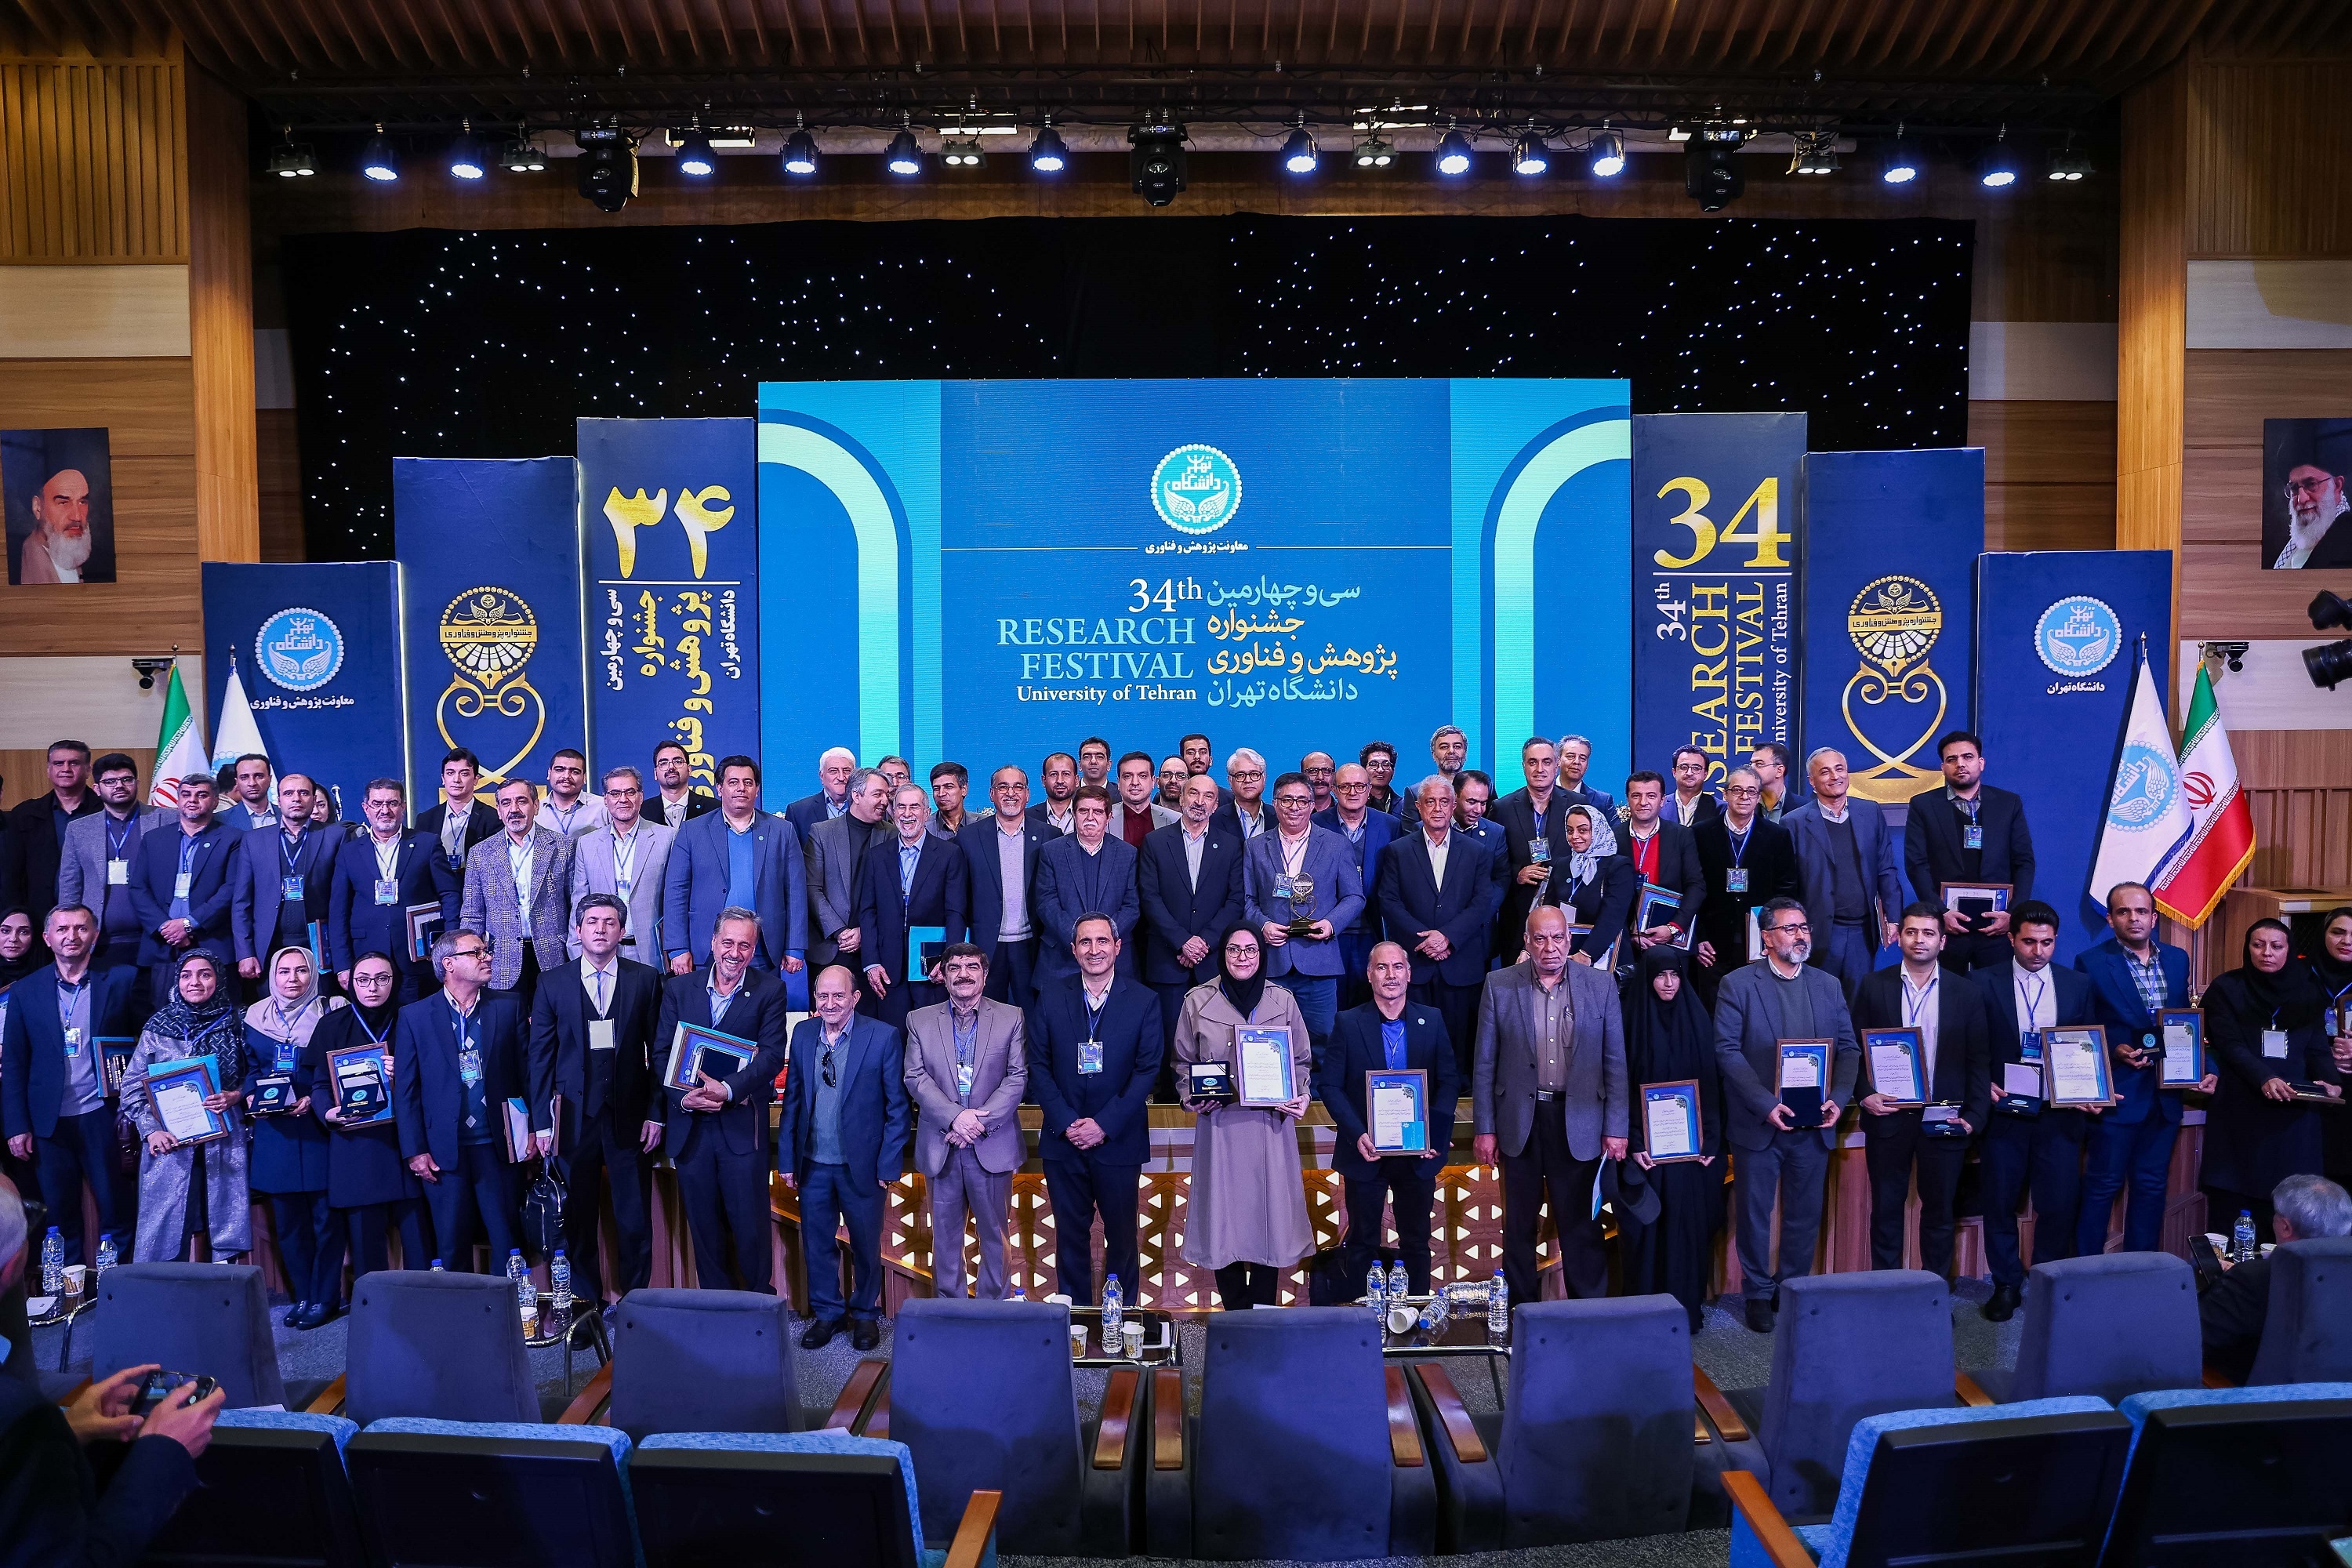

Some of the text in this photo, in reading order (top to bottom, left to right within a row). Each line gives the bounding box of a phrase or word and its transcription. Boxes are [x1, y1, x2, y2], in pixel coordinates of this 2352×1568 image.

[1171, 472, 1221, 490] دانشگاه
[602, 485, 735, 579] ۳۴
[1653, 476, 1791, 569] 34
[1145, 539, 1249, 554] معاونت پژوهش و فناوری
[1128, 576, 1203, 613] 34th
[1207, 574, 1303, 611] چهارمین
[1207, 608, 1305, 641] جشنواره
[1653, 582, 1686, 641] 34th
[2054, 621, 2101, 638] دانشگاه
[276, 633, 324, 651] دانشگاه
[631, 590, 665, 677] جشنواره
[720, 590, 741, 680] دانشگاه تهران
[996, 617, 1196, 645] RESEARCH
[600, 628, 624, 691] چهارمین
[1020, 652, 1194, 680] FESTIVAL
[1207, 641, 1398, 681] پژوهش و فناوری
[1734, 581, 1764, 755] FESTIVAL
[1770, 582, 1792, 745] niversity of Tehran
[250, 695, 354, 710] معاونت پژوهش و فناوری
[667, 590, 715, 798] پژوهش و فناور
[1017, 684, 1197, 706] University of Tehran
[1207, 674, 1359, 708] دانشگاه تهران
[1691, 582, 1729, 801] SEARCH
[2046, 681, 2105, 695] دانشگاه تهران
